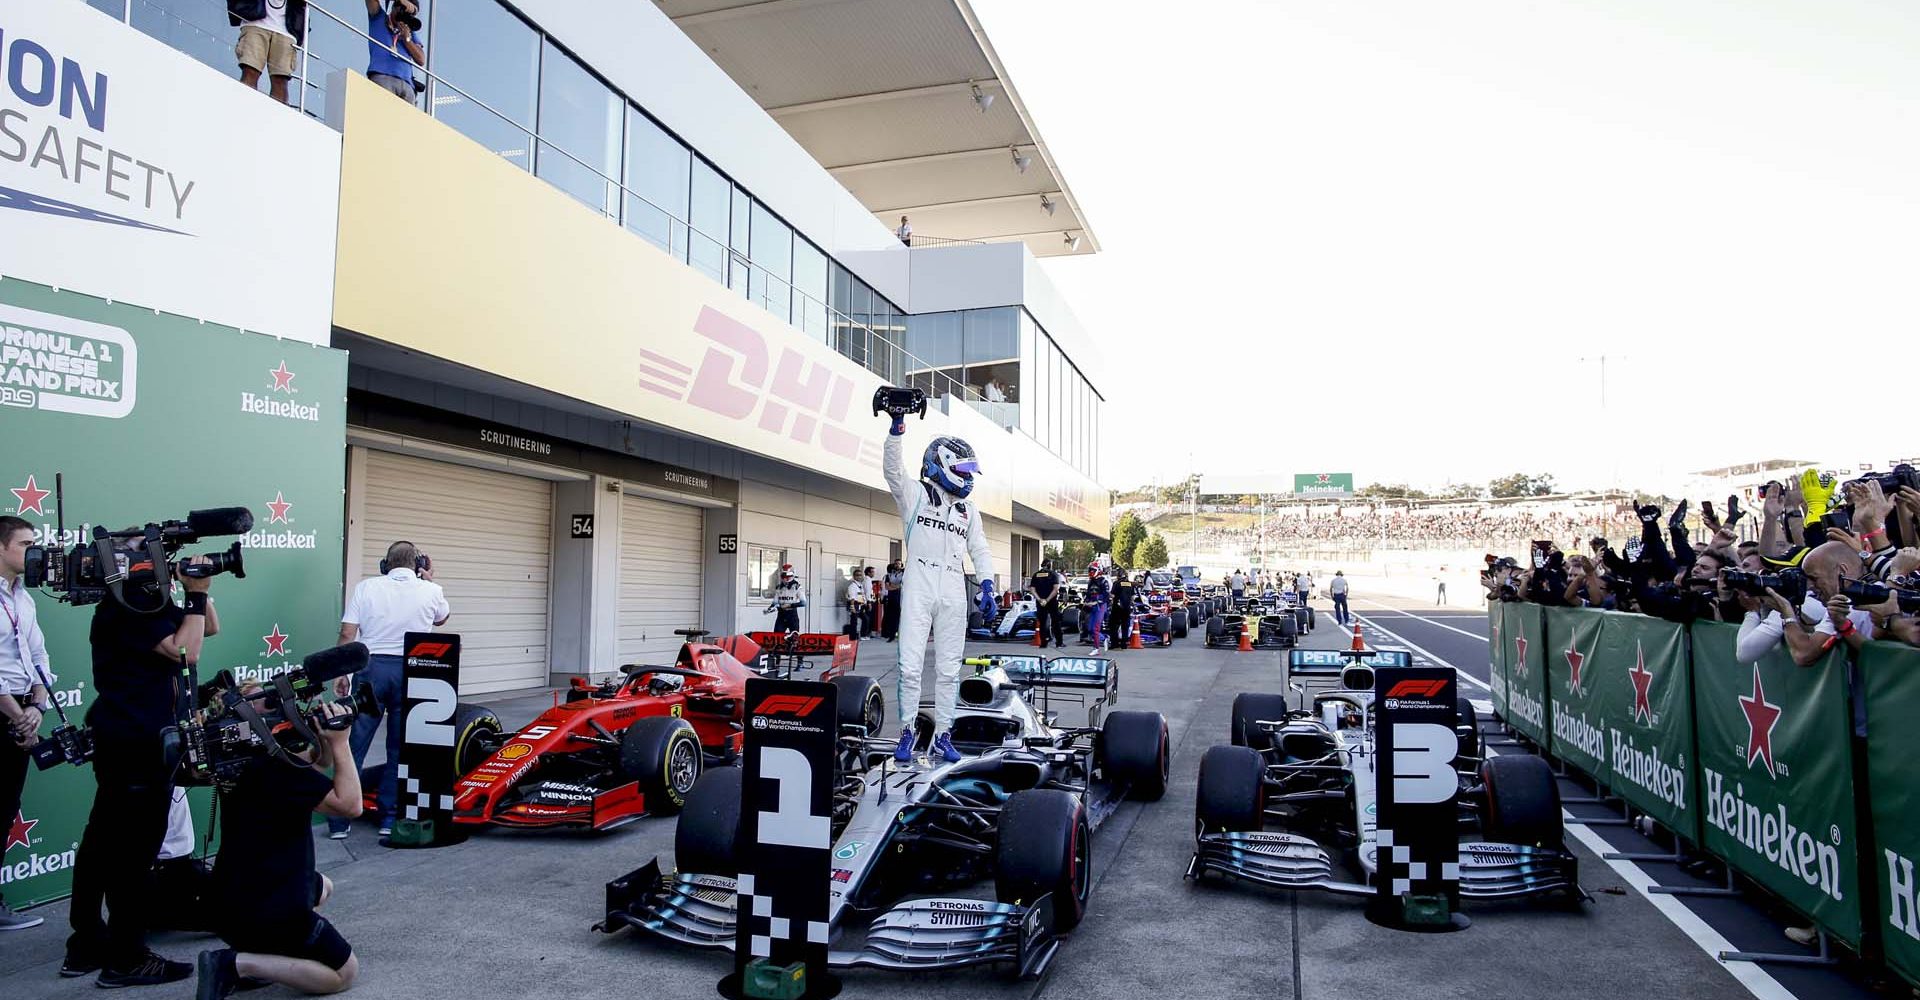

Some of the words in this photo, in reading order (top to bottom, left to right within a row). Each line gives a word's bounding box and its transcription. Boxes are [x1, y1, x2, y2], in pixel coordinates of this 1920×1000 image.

[0, 28, 107, 132] ON
[0, 109, 194, 219] SAFETY
[0, 345, 98, 378] PANESE
[65, 374, 119, 399] PRIX
[687, 304, 862, 461] DHL
[241, 391, 319, 421] Heineken
[480, 428, 551, 455] SCRUTINEERING
[664, 471, 709, 490] SCRUTINEERING
[1302, 484, 1345, 494] Heineken
[572, 517, 592, 535] 54
[239, 529, 315, 549] Heineken
[720, 536, 737, 551] 55
[760, 654, 769, 675] 5
[1303, 651, 1395, 664] PETRNAS
[405, 677, 458, 747] 2
[753, 718, 766, 727] FIA
[518, 726, 558, 740] 5
[1552, 699, 1605, 763] Heineken
[1736, 745, 1746, 759] EST.
[1393, 723, 1458, 803] 3
[1611, 728, 1686, 810] Heineken
[1775, 761, 1789, 777] 1873
[540, 791, 592, 801] WINNOW
[757, 746, 832, 850] 1
[1249, 834, 1291, 842] PETRONAS
[1704, 767, 1843, 901] Heineken
[699, 877, 737, 889] PETRONAS
[1885, 848, 1920, 941] H
[930, 901, 985, 911] PETRONAS
